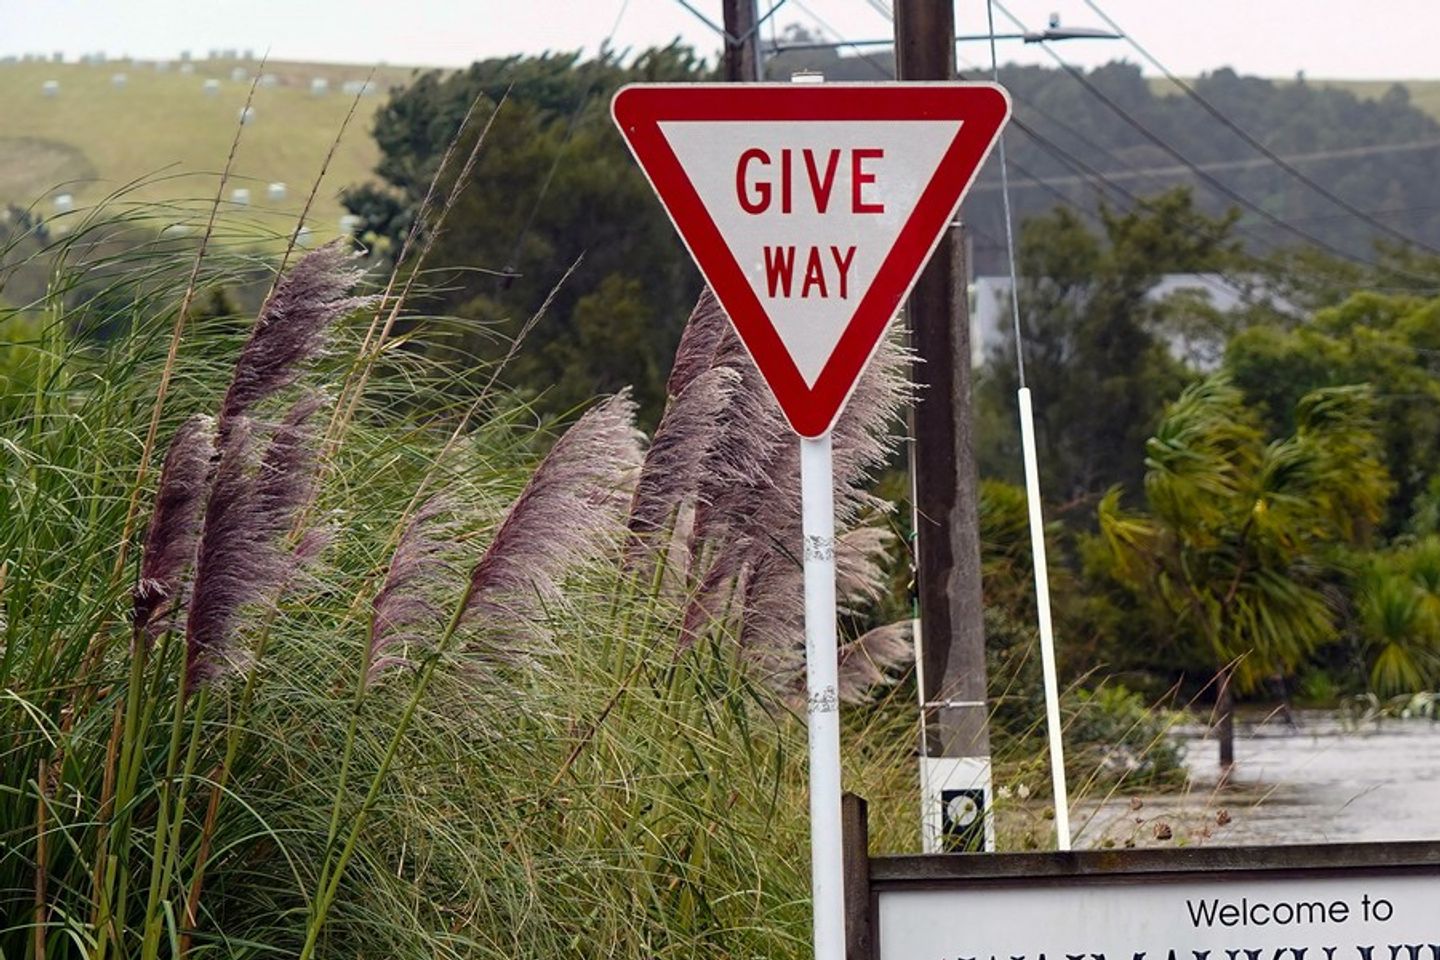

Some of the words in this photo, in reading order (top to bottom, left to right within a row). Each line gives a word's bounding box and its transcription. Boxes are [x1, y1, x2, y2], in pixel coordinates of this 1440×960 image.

[736, 148, 885, 215] GIVE
[764, 246, 857, 299] WAY
[1186, 898, 1349, 928] Welcome
[1362, 894, 1393, 922] to
